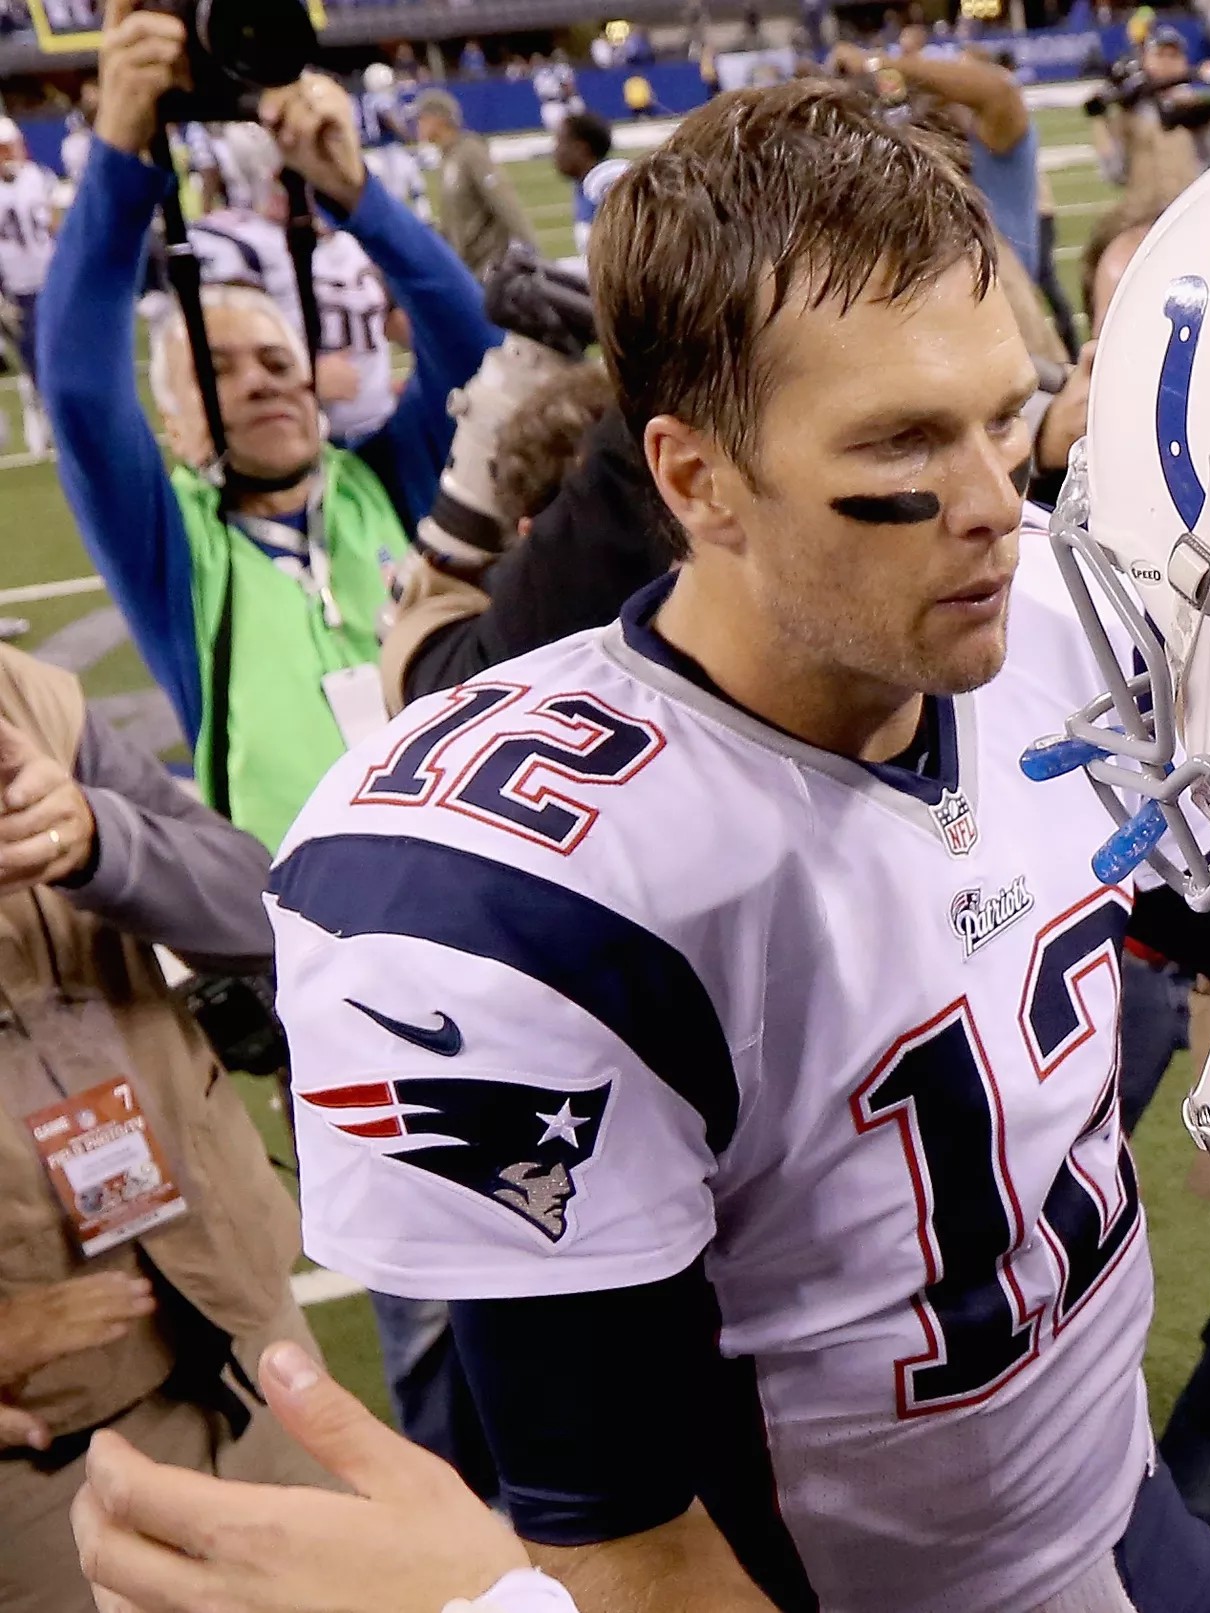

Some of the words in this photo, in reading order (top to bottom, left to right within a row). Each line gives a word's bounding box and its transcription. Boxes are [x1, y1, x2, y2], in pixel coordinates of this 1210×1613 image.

[350, 681, 668, 857] 12
[948, 816, 976, 850] NFL
[955, 873, 1034, 960] Patriots
[113, 1083, 133, 1112] 7
[849, 885, 1140, 1419] 12
